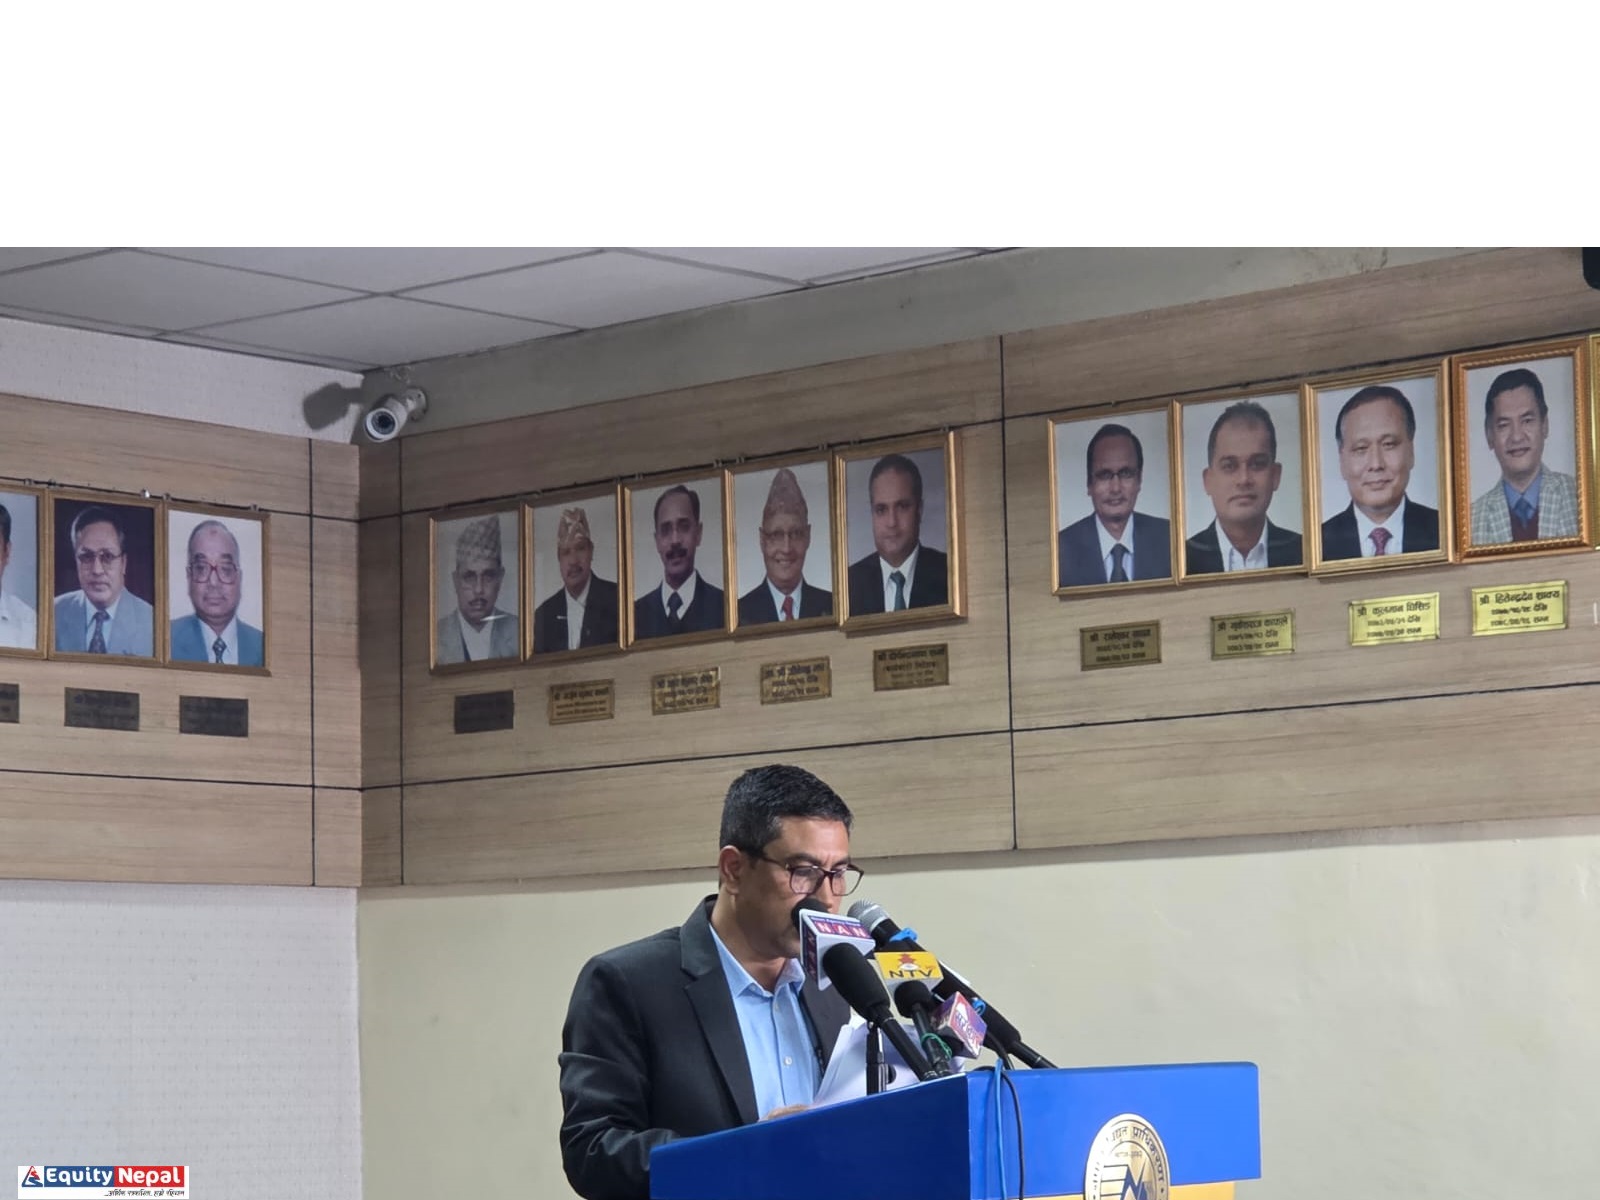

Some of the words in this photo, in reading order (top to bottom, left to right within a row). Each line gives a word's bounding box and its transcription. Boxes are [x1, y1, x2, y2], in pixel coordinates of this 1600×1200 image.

[1480, 594, 1490, 605] श्री
[1357, 606, 1368, 618] श्री
[889, 969, 932, 978] NTV
